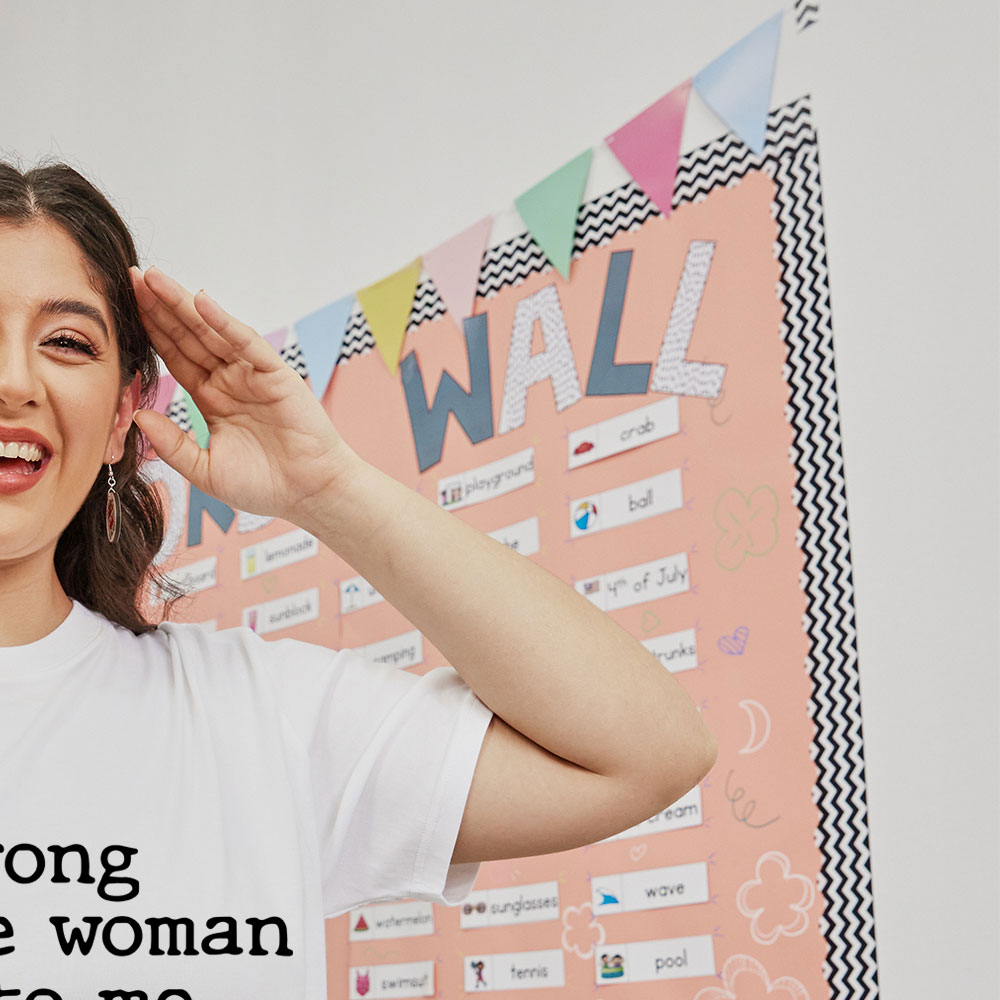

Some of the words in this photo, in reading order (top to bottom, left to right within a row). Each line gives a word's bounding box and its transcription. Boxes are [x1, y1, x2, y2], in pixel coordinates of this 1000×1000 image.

[400, 240, 727, 473] WALL
[620, 416, 655, 442] crab
[464, 459, 534, 497] playground
[628, 489, 655, 513] ball
[633, 572, 650, 590] of
[656, 565, 688, 588] July
[644, 880, 685, 899] wave
[490, 896, 558, 916] sunglasses
[49, 915, 293, 957] woman
[510, 964, 549, 980] tennis
[655, 948, 689, 973] pool
